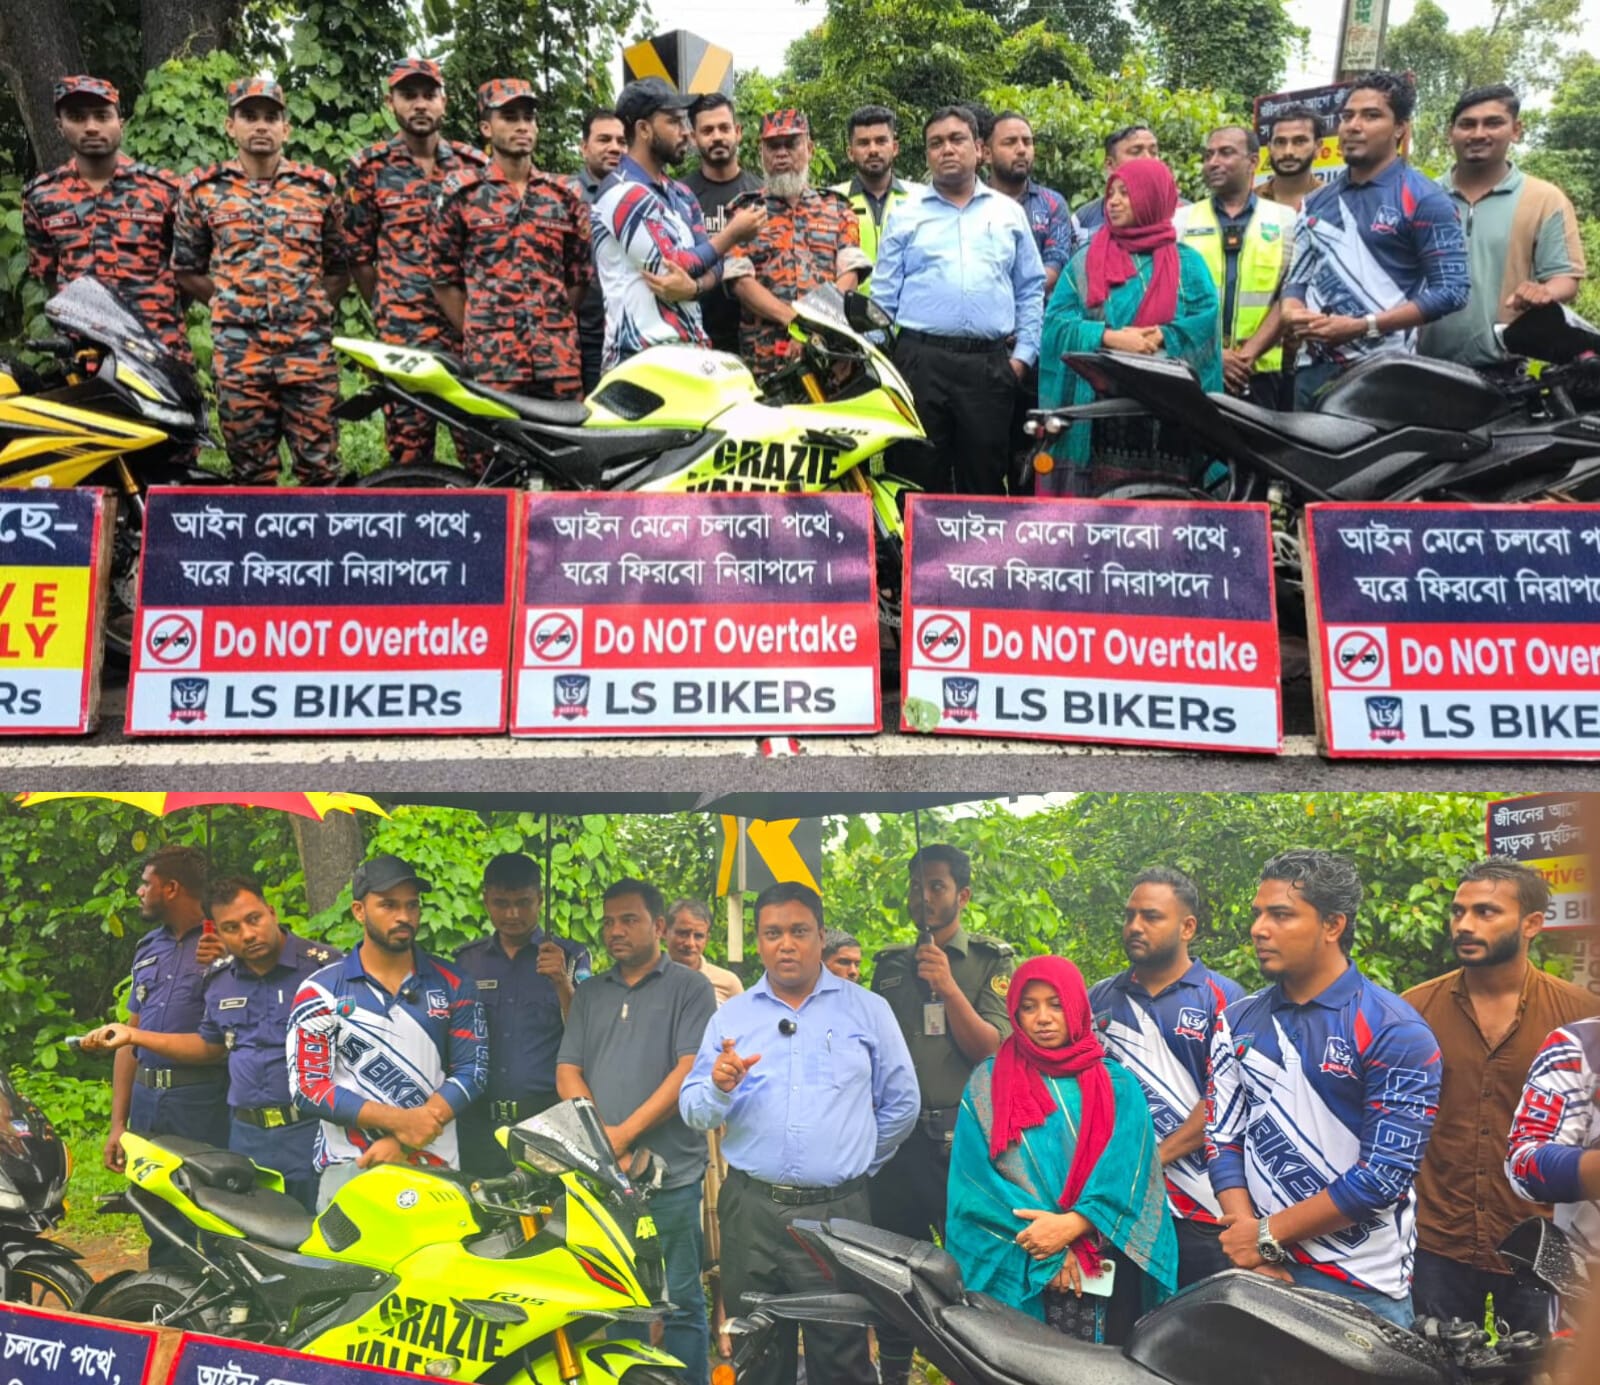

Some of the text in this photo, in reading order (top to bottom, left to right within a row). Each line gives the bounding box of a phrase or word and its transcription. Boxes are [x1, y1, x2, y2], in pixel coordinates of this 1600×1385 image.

[712, 438, 841, 485] GRAZIE
[172, 508, 482, 542] আইন মেনে চলবো পথে,
[551, 508, 846, 544] আইন মেনে চলবো পথে,
[936, 510, 1242, 559] আইন মেনে চলবো পথে,
[1338, 519, 1412, 555] আইন
[1422, 528, 1486, 555] মেনে
[1491, 523, 1572, 556] চলবো
[181, 561, 230, 587] ঘরে
[242, 553, 334, 587] ফিরবো
[343, 553, 452, 587] নিরাপদে
[561, 562, 612, 586] ঘরে
[618, 552, 706, 587] ফিরবো
[714, 552, 818, 587] নিরাপদে
[947, 563, 997, 590] ঘরে
[1004, 557, 1094, 595] ফিরবো
[1101, 561, 1213, 600] নিরাপদে
[1354, 576, 1409, 604] ঘরে
[1415, 567, 1509, 605] ফিরবো
[213, 617, 489, 658] Do NOT Overtake
[594, 615, 858, 654] Do NOT Overtake
[982, 622, 1259, 673] Do NOT Overtake
[1401, 636, 1600, 677] Do NOT Over
[224, 683, 462, 719] LS BIKERs
[606, 680, 837, 715] LS BIKERs
[995, 686, 1238, 734] LS BIKERs
[1420, 703, 1600, 739] LS BIKE
[1493, 806, 1545, 827] জীবনের
[1494, 832, 1536, 855] সড়ক
[379, 1291, 507, 1363] GRAZIE
[4, 1332, 67, 1372] চলবো
